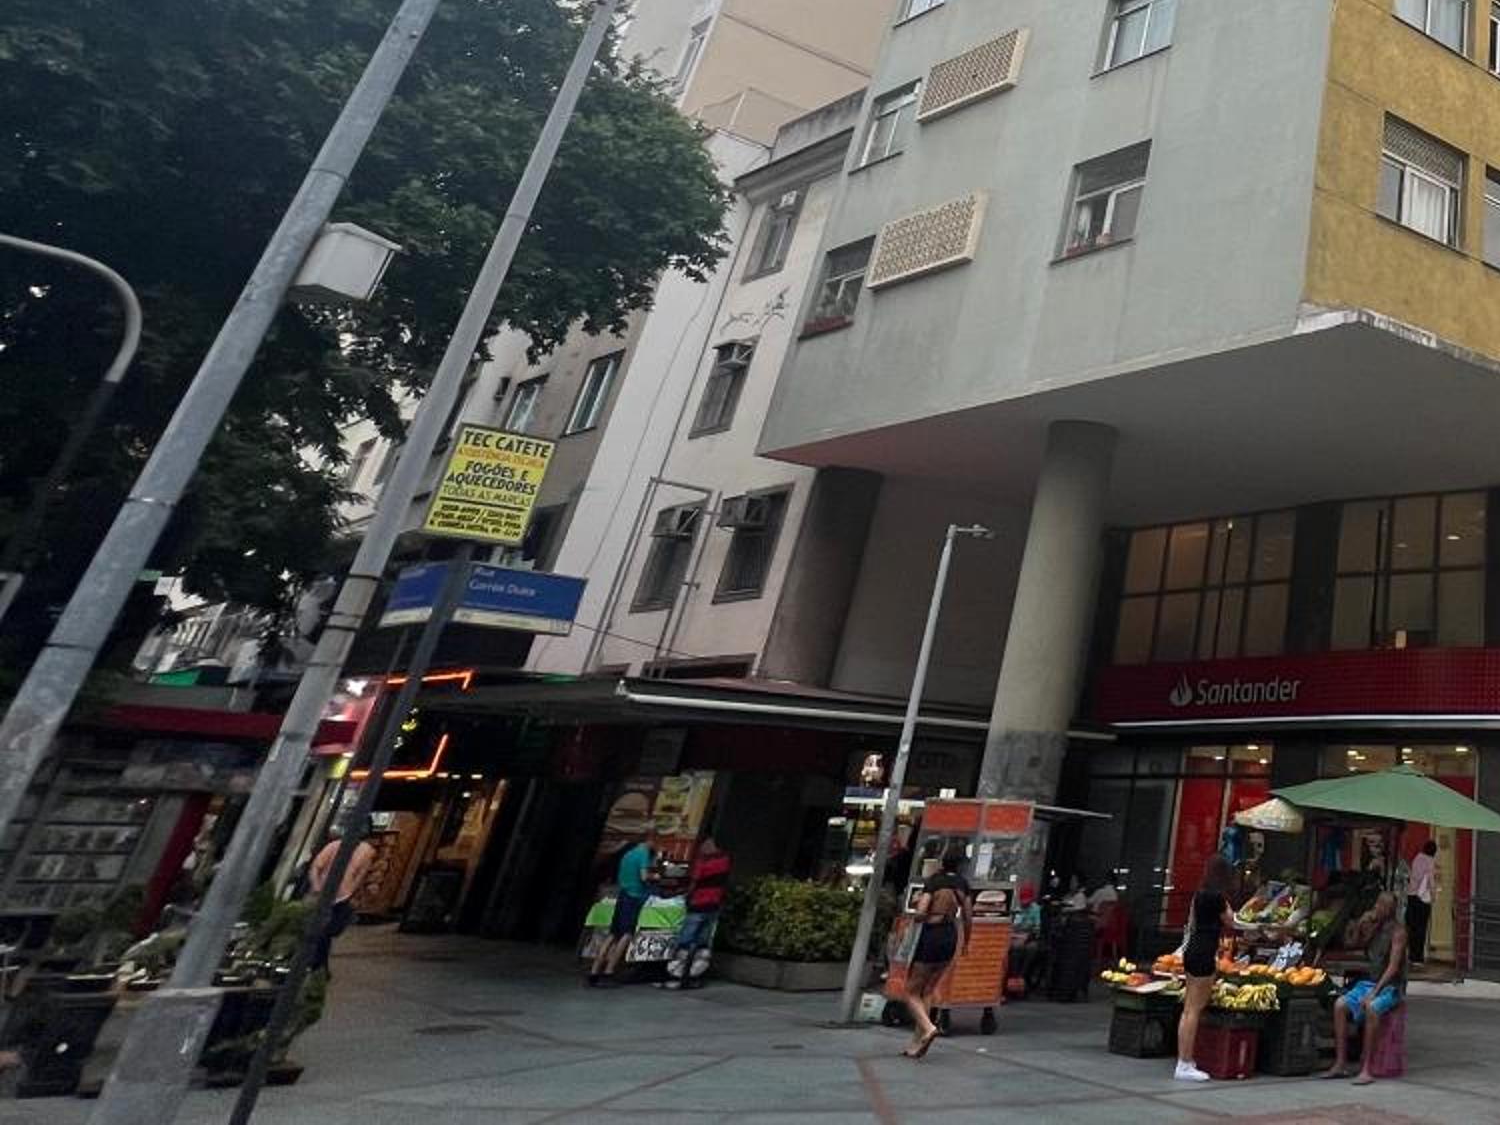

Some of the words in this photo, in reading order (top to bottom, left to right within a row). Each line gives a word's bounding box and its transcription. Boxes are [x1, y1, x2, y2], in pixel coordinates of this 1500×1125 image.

[464, 431, 493, 448] TEC
[495, 437, 551, 458] CATETE
[446, 471, 536, 496] AQUECEDORES
[1195, 674, 1300, 706] Santander
